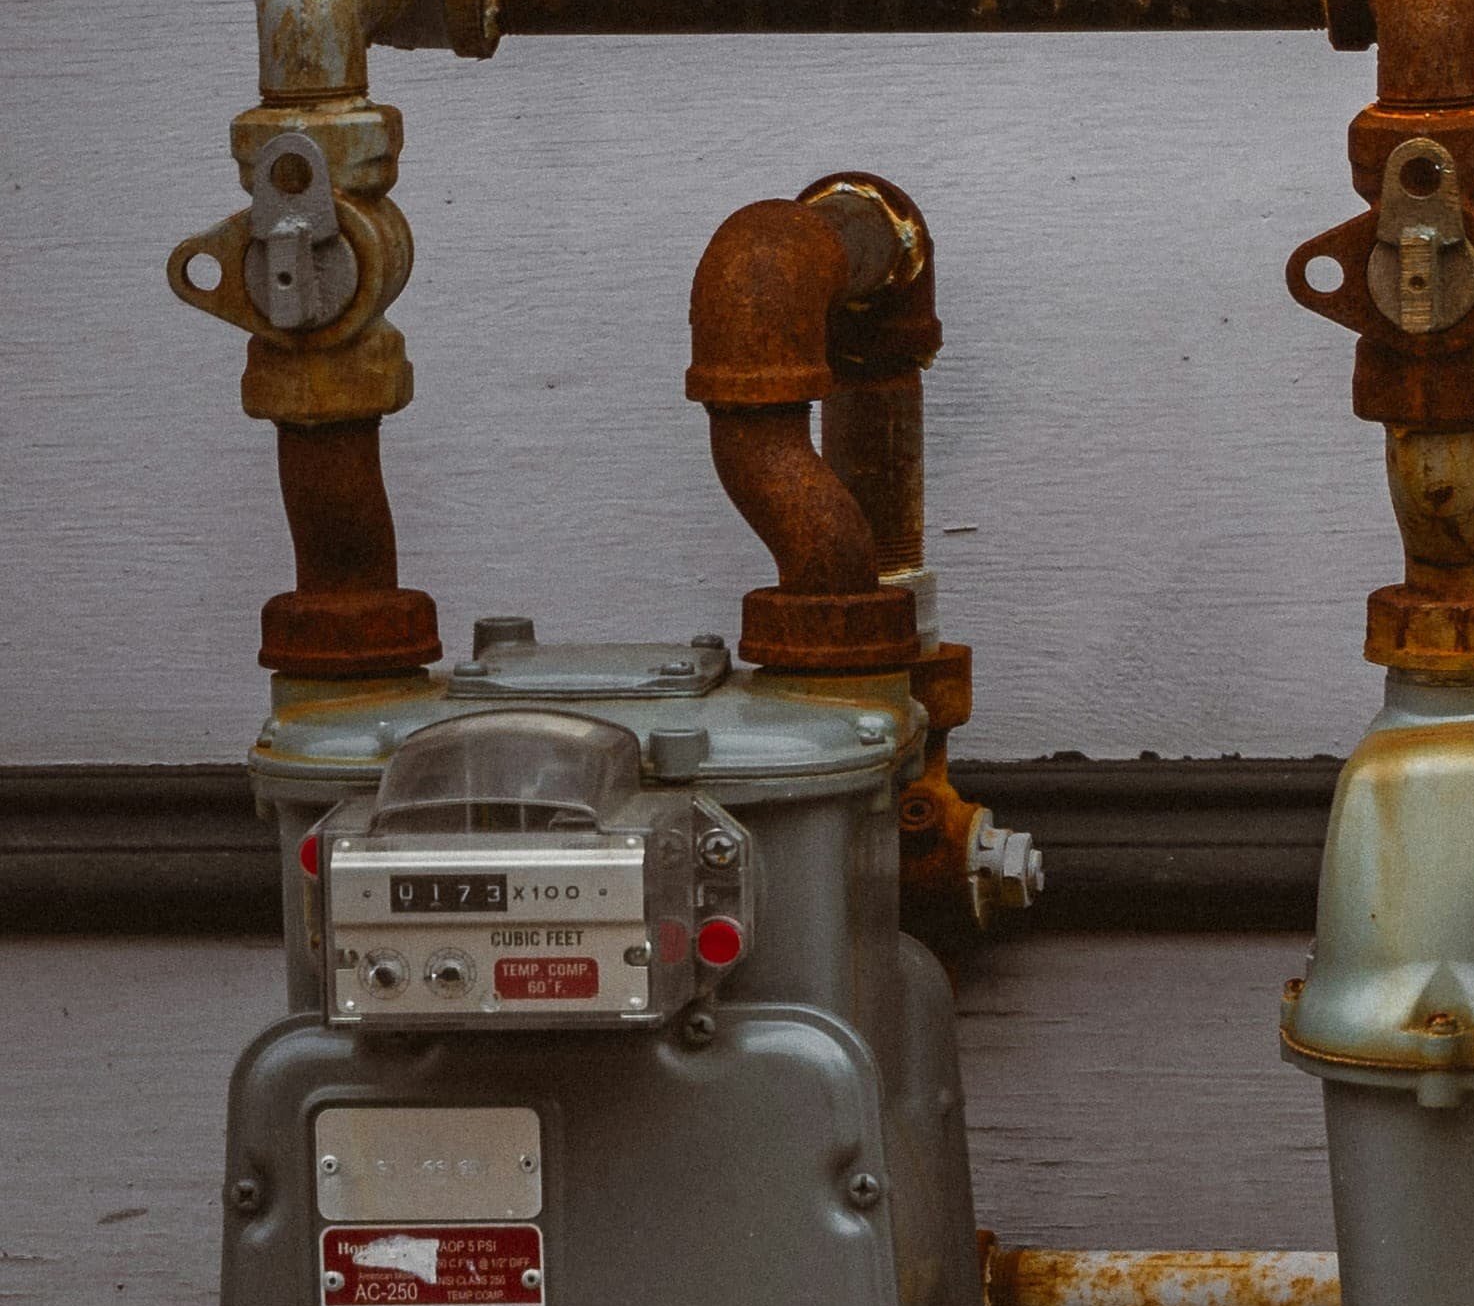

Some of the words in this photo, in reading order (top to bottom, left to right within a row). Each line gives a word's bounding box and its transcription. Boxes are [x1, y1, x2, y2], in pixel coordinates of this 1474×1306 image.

[490, 931, 541, 947] CUBIC
[546, 930, 585, 947] FEET
[439, 1240, 465, 1253] AOP
[467, 1241, 475, 1252] 5
[477, 1240, 497, 1252] PSI
[354, 1283, 418, 1302] AC-250
